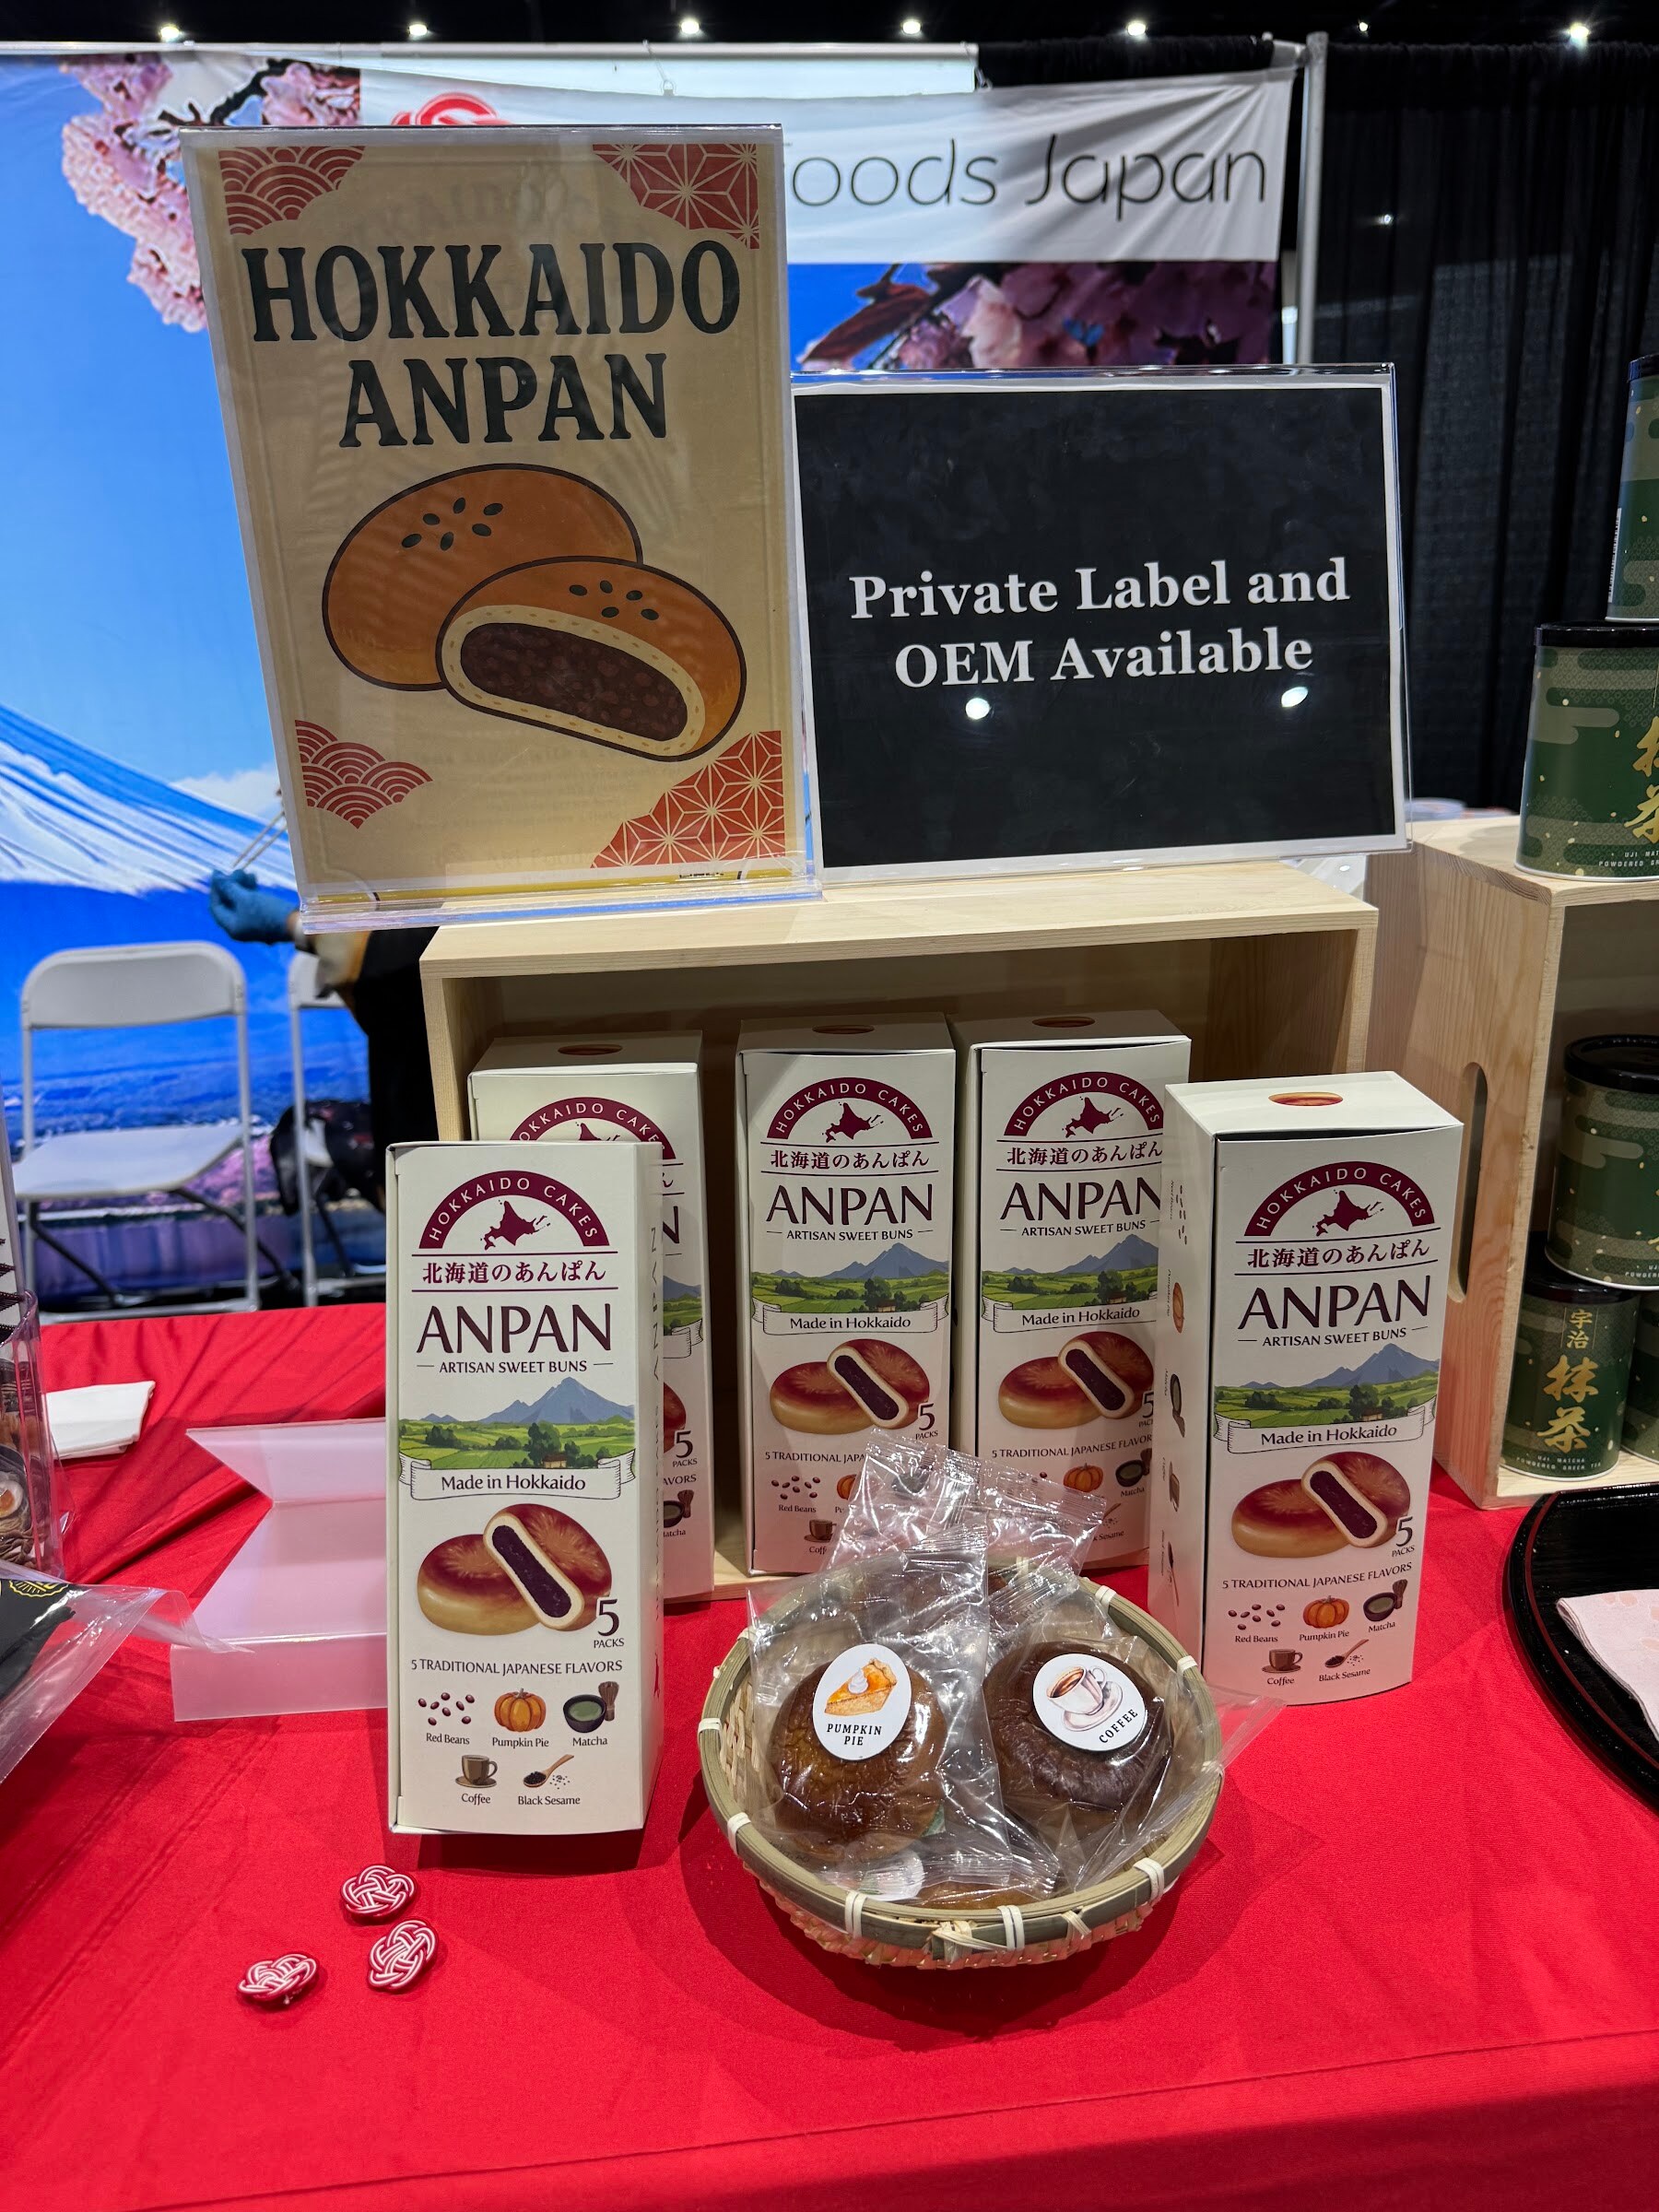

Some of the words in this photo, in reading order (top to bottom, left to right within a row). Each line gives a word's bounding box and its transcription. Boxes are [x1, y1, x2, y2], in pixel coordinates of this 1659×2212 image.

[791, 138, 998, 206] oods
[1025, 134, 1265, 221] Japan
[241, 239, 741, 342] HOKKAIDO
[338, 352, 668, 448] ANPAN
[848, 570, 1059, 619] Private
[1075, 559, 1231, 610] Label
[1246, 557, 1351, 605] and
[894, 639, 1035, 688] OEM
[1049, 626, 1314, 682] Available
[775, 1083, 866, 1133] HOKKAIDO
[877, 1089, 924, 1132] CAKES
[1014, 1077, 1108, 1131] HOKKAIDO
[1119, 1082, 1161, 1124] CAKES
[519, 1102, 604, 1142] OKKAIDO
[616, 1109, 665, 1149] CAKE
[771, 1149, 930, 1170] 北海道のあんぱん
[1006, 1141, 1163, 1165] 北海道のあんぱん
[765, 1183, 933, 1226] ANPAN
[1256, 1167, 1367, 1230] HOKKAIDO
[1380, 1173, 1426, 1218] CAKES
[429, 1177, 530, 1241] HOKKAIDO
[544, 1185, 598, 1238] CAKES
[786, 1230, 836, 1241] ARTISAN
[839, 1230, 878, 1241] SWEET
[881, 1229, 913, 1240] BUNS
[1021, 1227, 1072, 1237] ARTISAN
[1075, 1224, 1114, 1235] SWEET
[1116, 1219, 1147, 1232] BUNS
[1247, 1239, 1430, 1268] 北海道のあんぱん
[422, 1260, 606, 1284] 北海道のあんぱん
[1237, 1275, 1430, 1330] ANPAN
[790, 1318, 827, 1329] Made
[830, 1317, 842, 1328] in
[846, 1316, 911, 1328] Hokkaido
[1022, 1313, 1059, 1326] Made
[1063, 1312, 1075, 1324] in
[1078, 1307, 1140, 1322] Hokkaido
[416, 1303, 611, 1354] ANPAN
[1262, 1335, 1321, 1347] ARTISAN
[1324, 1332, 1370, 1345] SWEET
[1372, 1327, 1407, 1341] BUNS
[1567, 1309, 1593, 1349] 宇治
[440, 1361, 495, 1373] ARTISAN
[498, 1361, 545, 1373] SWEET
[548, 1360, 587, 1372] BUNS
[1536, 1354, 1599, 1453] 抹茶
[918, 1403, 935, 1430] 5
[676, 1430, 693, 1458] 5
[915, 1430, 938, 1440] PACKS
[1261, 1431, 1304, 1446] Made
[1307, 1430, 1322, 1442] in
[1326, 1425, 1397, 1441] Hokkaido
[992, 1450, 997, 1458] 5
[999, 1448, 1068, 1458] TRADITIONAL
[1070, 1442, 1116, 1456] JAPANESE
[1118, 1434, 1152, 1448] FLAVOR
[673, 1458, 698, 1467] PACKS
[765, 1452, 771, 1460] 5
[772, 1452, 841, 1463] TRADITIONAL
[843, 1453, 865, 1464] JAPA
[441, 1476, 484, 1490] Made
[488, 1475, 502, 1489] in
[507, 1475, 586, 1490] Hokkaido
[663, 1474, 697, 1486] AVORS
[663, 1529, 687, 1537] atcha
[1395, 1516, 1414, 1547] 5
[809, 1547, 828, 1556] Coff
[1391, 1546, 1416, 1558] PACKS
[1222, 1580, 1229, 1589] 5
[1231, 1578, 1310, 1588] TRADITIONAL
[1312, 1572, 1366, 1588] JAPANESE
[1368, 1561, 1413, 1580] FLAVORS
[597, 1599, 620, 1637] 5
[1368, 1620, 1395, 1633] Matcha
[593, 1638, 625, 1649] PACKS
[1299, 1632, 1336, 1642] Pumpkin
[1337, 1630, 1350, 1639] Pie
[411, 1659, 418, 1670] 5
[419, 1658, 500, 1675] TRADITIONAL
[502, 1662, 562, 1677] JAPANESE
[565, 1660, 623, 1674] FLAVORS
[1318, 1672, 1340, 1682] Black
[1342, 1667, 1371, 1679] Sesame
[1267, 1677, 1295, 1686] Coffee
[827, 1723, 882, 1735] PUMPKIN
[1099, 1709, 1138, 1744] COFFEE
[426, 1733, 442, 1743] Red
[444, 1734, 470, 1745] Beans
[492, 1737, 533, 1749] Pumpkin
[535, 1737, 549, 1747] Pie
[572, 1736, 608, 1747] Matcha
[843, 1735, 864, 1746] PIE
[461, 1793, 491, 1806] Coffee
[518, 1795, 543, 1805] Black
[545, 1796, 581, 1806] Sesame
